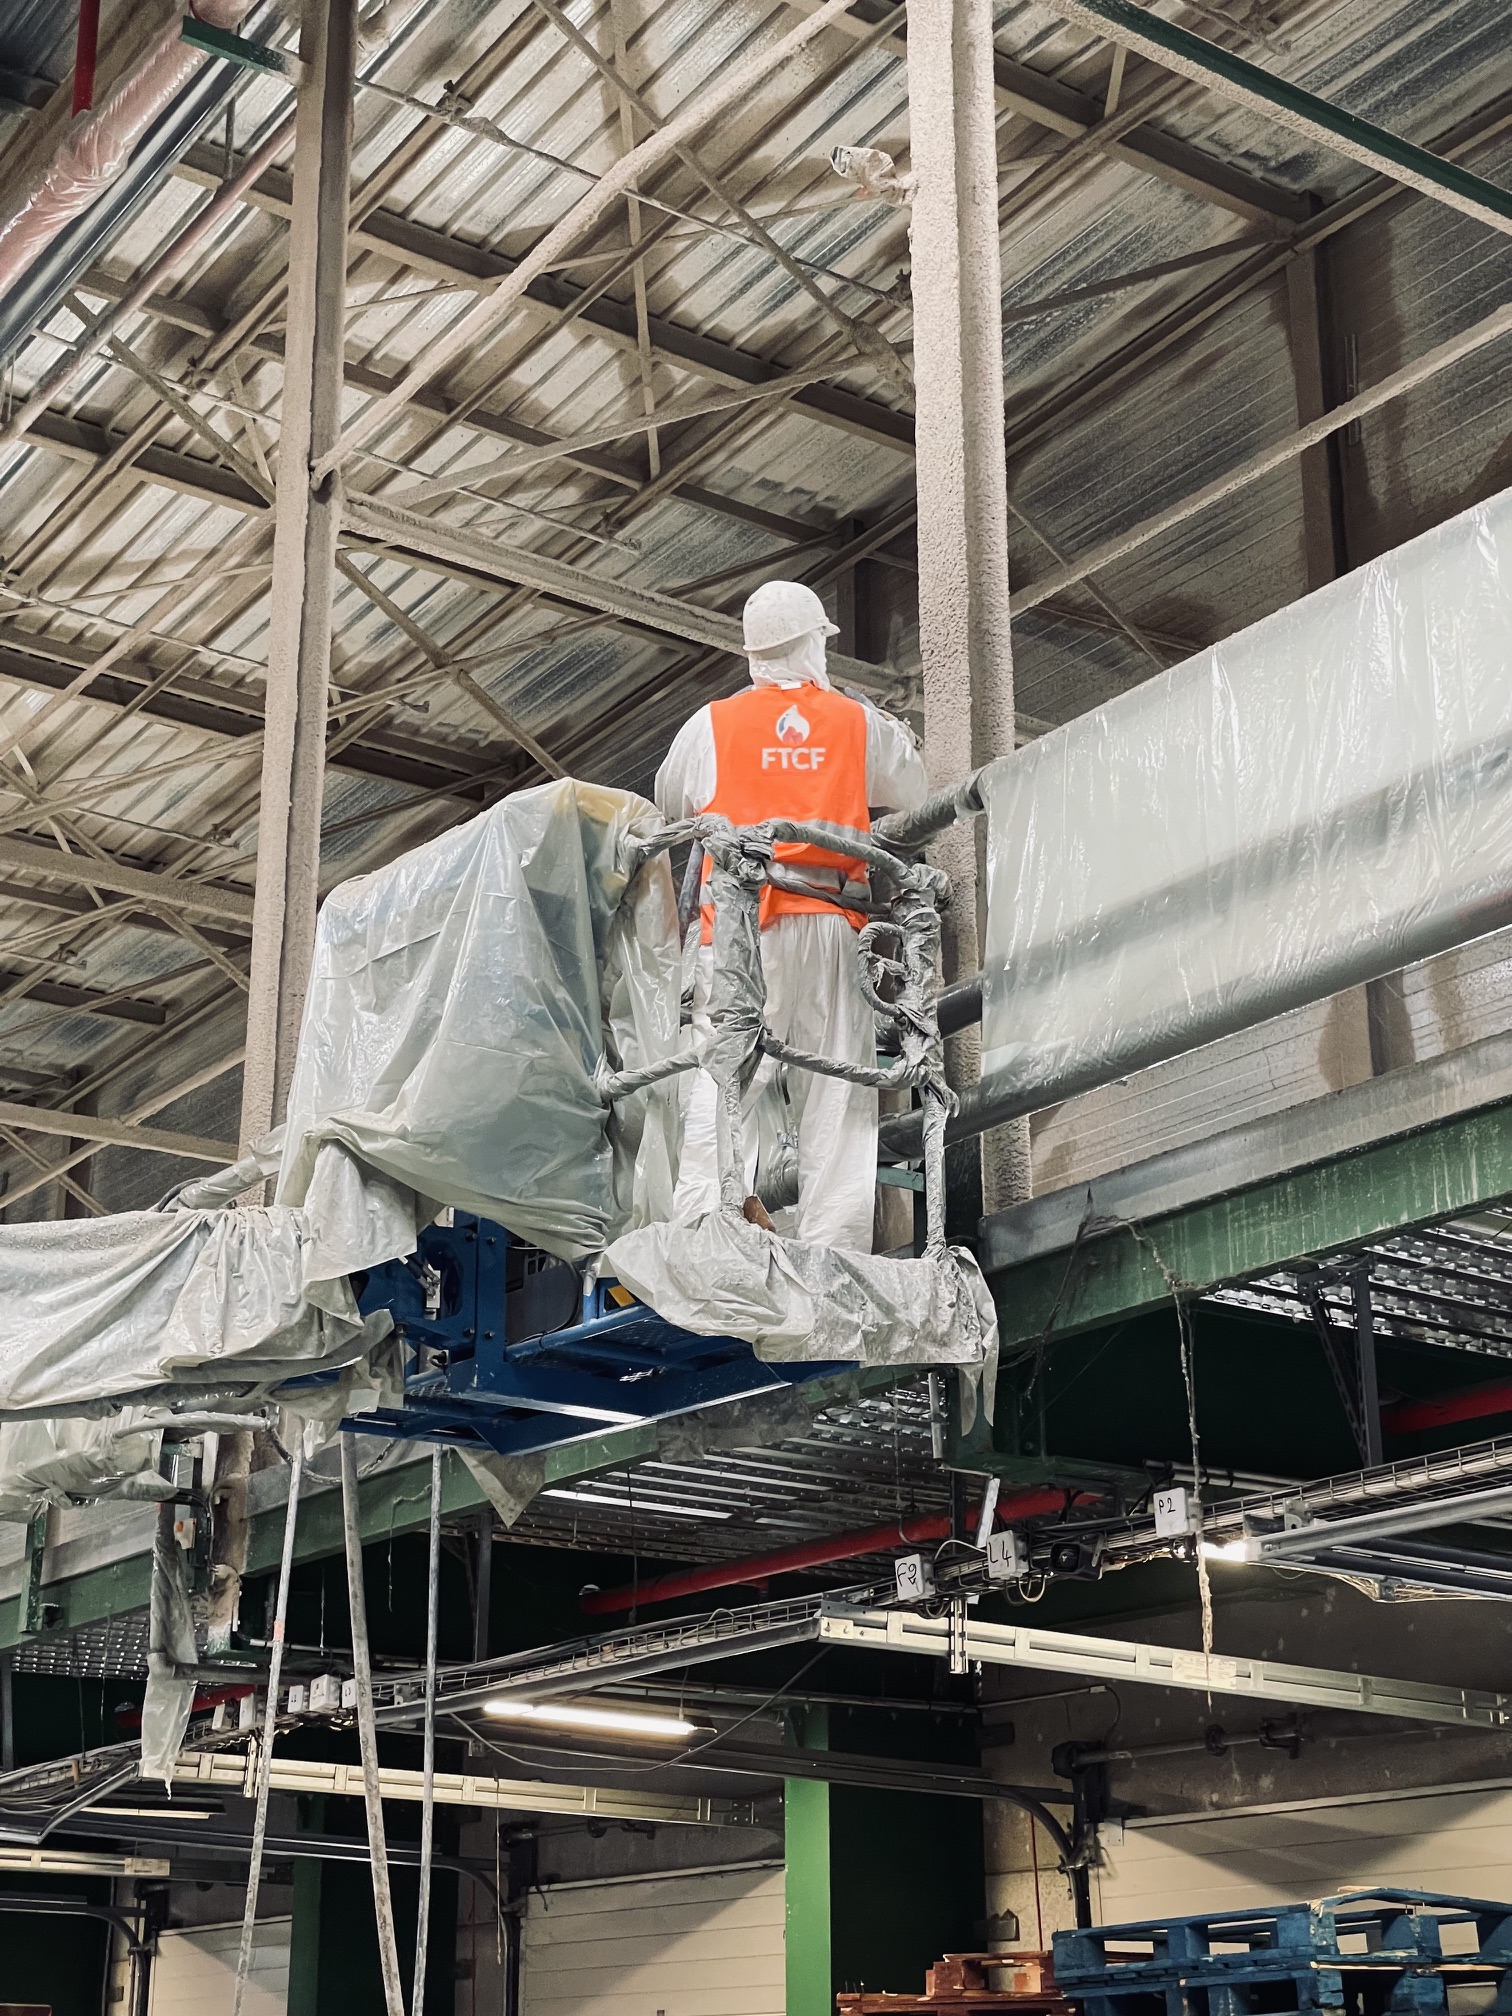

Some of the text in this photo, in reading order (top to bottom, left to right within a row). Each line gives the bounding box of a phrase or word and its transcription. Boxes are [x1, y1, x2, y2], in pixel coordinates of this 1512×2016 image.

[761, 747, 826, 770] FTCF
[1158, 1497, 1176, 1514] P2
[988, 1540, 1012, 1567] L4
